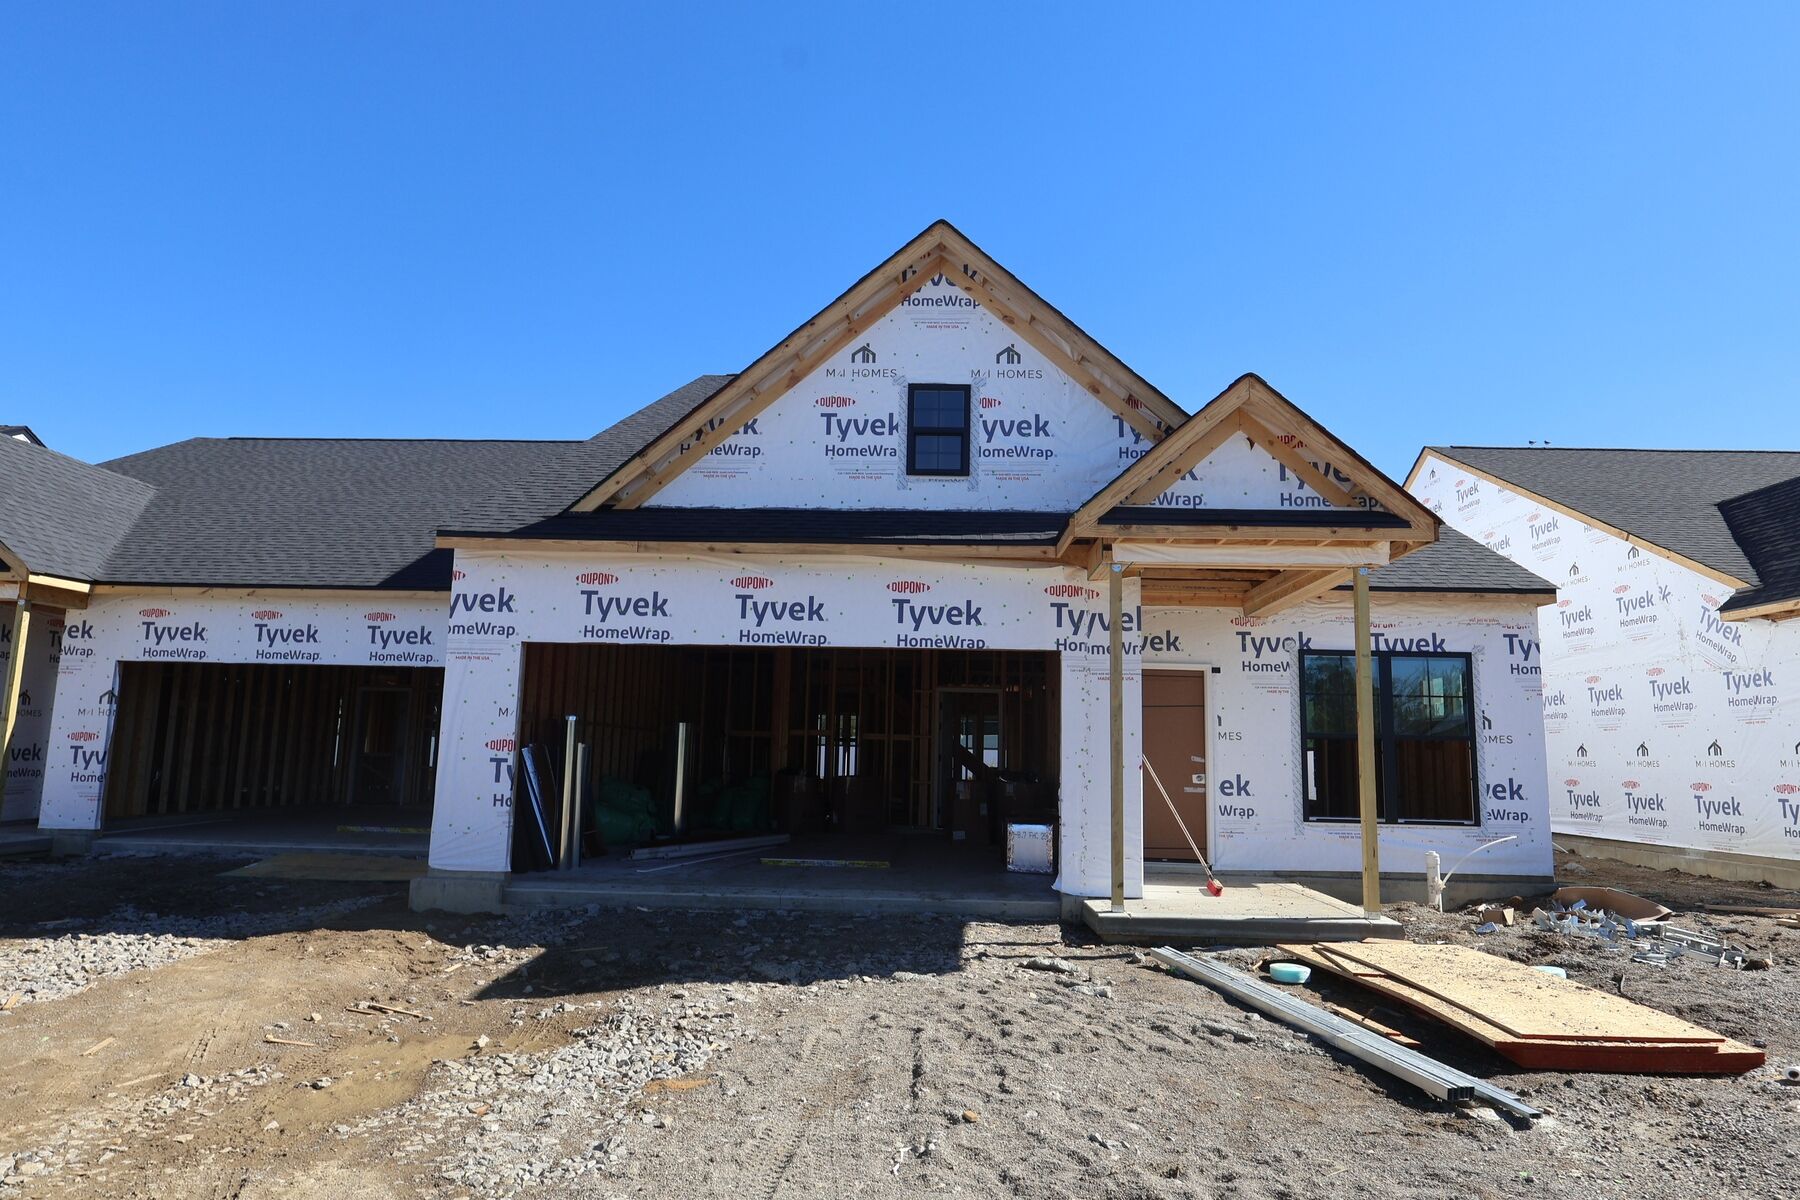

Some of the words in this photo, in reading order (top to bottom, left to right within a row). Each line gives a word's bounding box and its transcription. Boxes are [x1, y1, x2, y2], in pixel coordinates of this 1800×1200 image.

[852, 368, 897, 378] HOMES
[997, 369, 1043, 379] HOMES
[820, 396, 852, 408] DUPONT
[820, 412, 899, 442] Tyvek
[979, 413, 1050, 443] yvek
[1456, 481, 1479, 503] Tyvek
[1529, 516, 1559, 541] Tyvek
[1629, 559, 1650, 571] HOMES
[580, 573, 614, 585] DUPONT
[735, 577, 769, 589] DUPONT
[891, 581, 925, 594] DUPONT
[1049, 585, 1084, 598] DUPONT
[580, 590, 669, 623] Tyvek
[1616, 590, 1654, 616] Tyvek
[142, 608, 167, 618] DUPONT
[254, 610, 280, 620] DUPONT
[367, 612, 393, 622] DUPONT
[735, 594, 824, 627] Tyvek
[892, 598, 983, 632] Tyvek
[1560, 605, 1592, 628] Tyvek
[1620, 614, 1657, 628] HomeWrap
[1700, 605, 1742, 647] Tyvek
[142, 621, 206, 646] Tyvek
[254, 623, 319, 648] Tyvek
[367, 625, 433, 650] Tyvek
[583, 625, 671, 643] HomeWrap
[739, 629, 827, 646] HomeWrap
[1562, 627, 1594, 638] HomeWrap
[896, 634, 986, 650] HomeWrap
[1695, 630, 1737, 663] HomeWrap
[143, 647, 206, 660] HomeWrap
[255, 649, 320, 662] HomeWrap
[369, 651, 433, 664] HomeWrap
[1649, 676, 1691, 701] Tyvek
[1723, 669, 1773, 695] Tyvek
[1588, 684, 1623, 706] Tyvek
[1728, 695, 1778, 707] HomeWrap
[1591, 707, 1626, 717] HomeWrap
[1653, 702, 1694, 713] HomeWrap
[70, 731, 97, 742] DUPONT
[1577, 760, 1597, 768] HOMES
[1637, 760, 1660, 768] HOMES
[1709, 760, 1736, 768] HOMES
[71, 771, 106, 783] Home
[1567, 789, 1601, 810] Tyvek
[1625, 792, 1664, 814] Tyvek
[1694, 794, 1741, 820] Tyvek
[1570, 810, 1603, 823] HomeWrap
[1629, 815, 1668, 829] HomeWrap
[1699, 821, 1746, 836] HomeWrap
